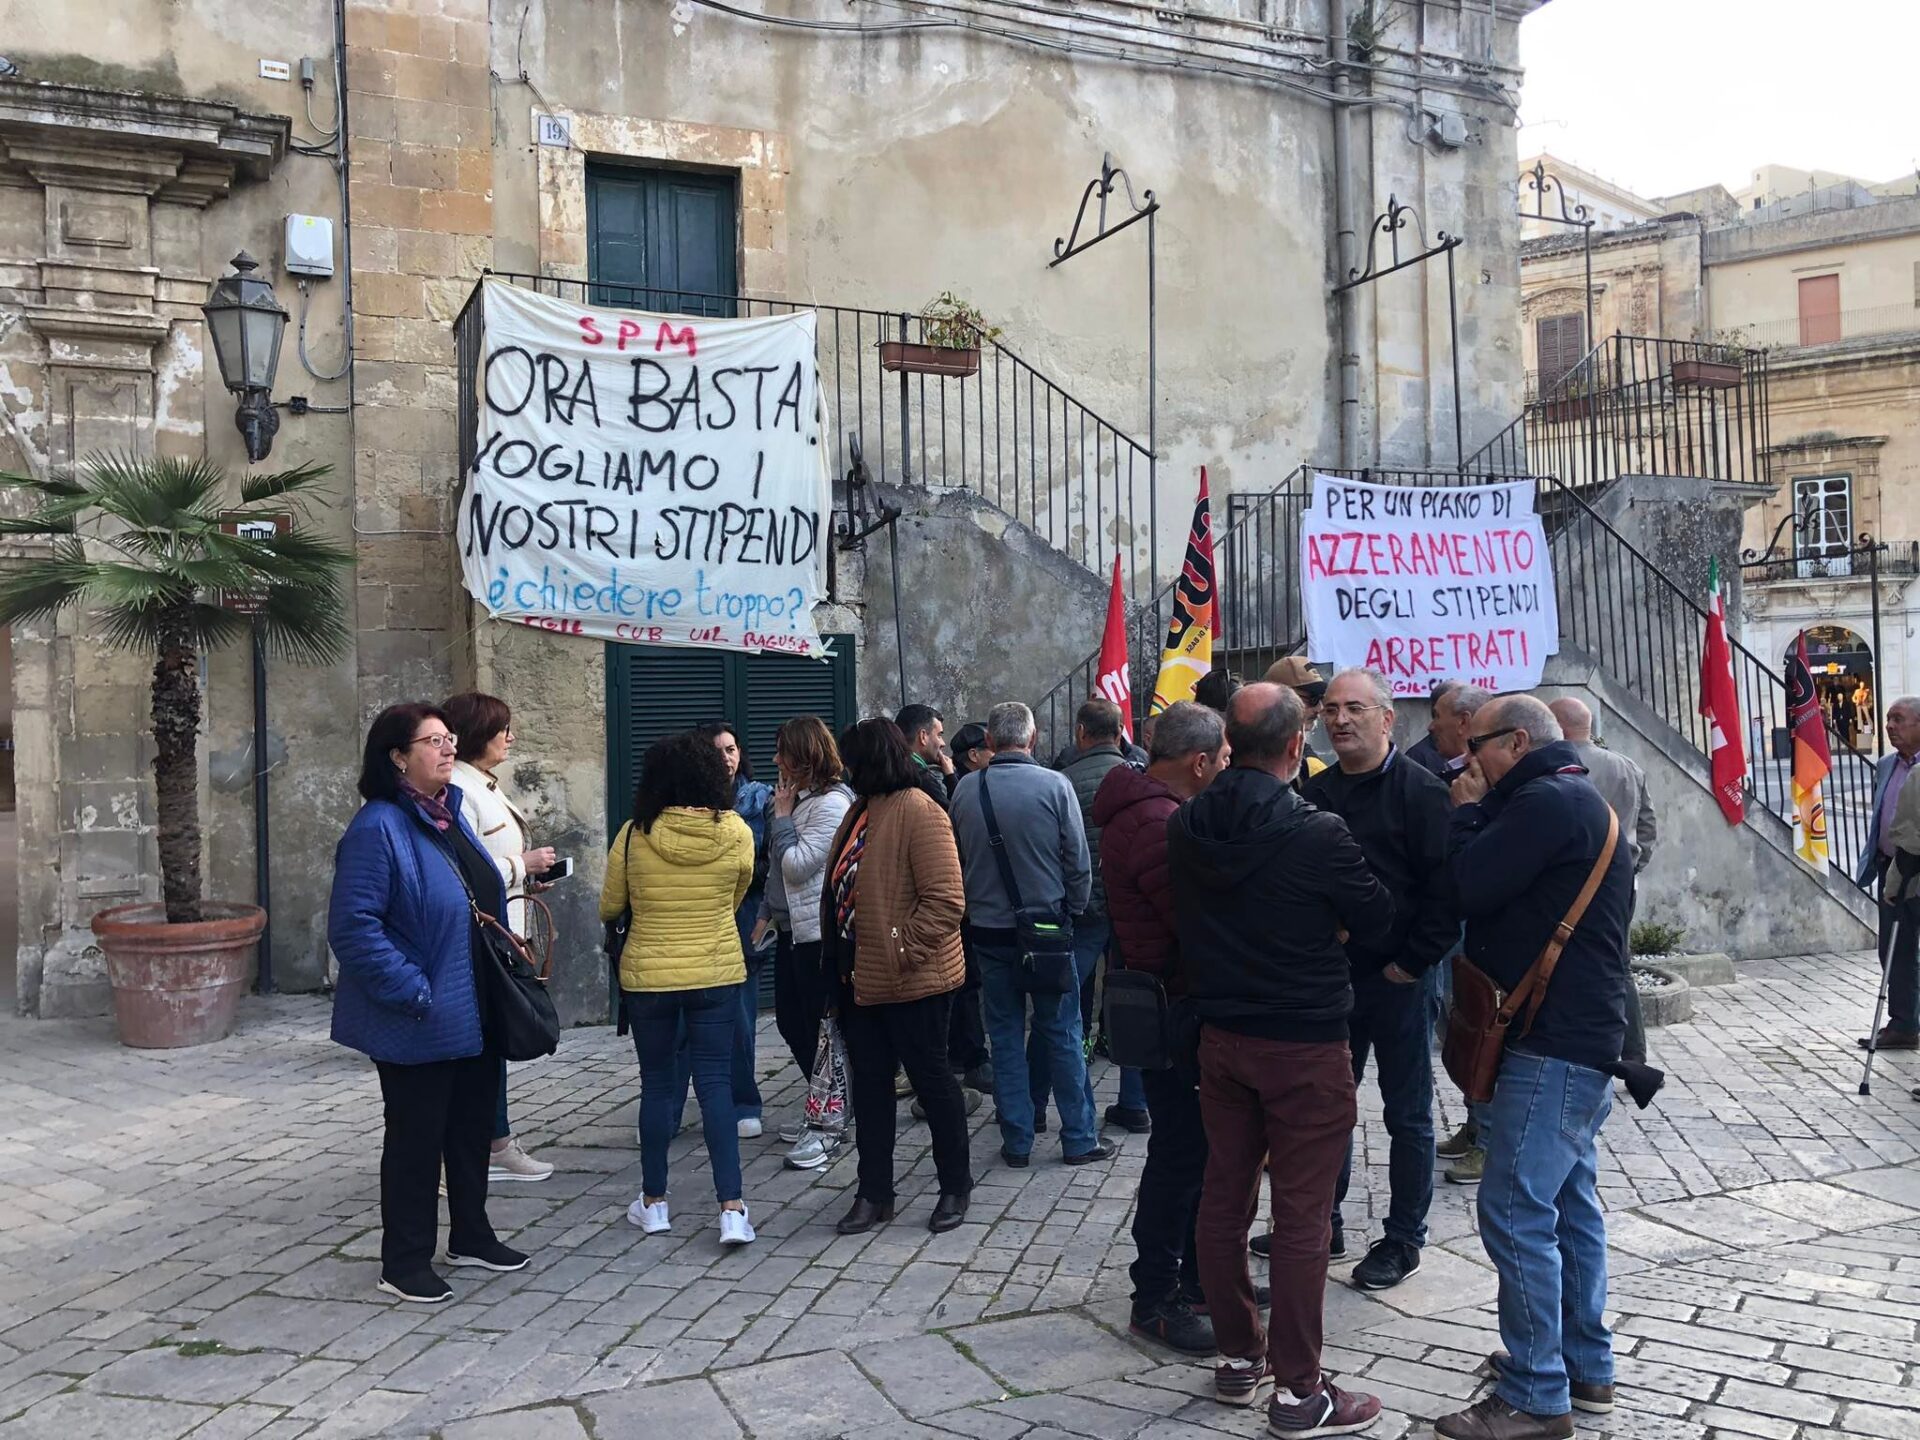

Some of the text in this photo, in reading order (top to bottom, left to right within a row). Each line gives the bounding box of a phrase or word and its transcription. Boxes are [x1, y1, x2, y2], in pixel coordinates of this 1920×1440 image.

[547, 122, 562, 140] 19
[577, 316, 697, 358] SPM
[485, 346, 601, 428] ORA
[752, 450, 765, 499] I
[1326, 487, 1511, 520] PER UN PIANO DI
[466, 493, 820, 566] NOSTRI STIPENDI
[1307, 529, 1534, 581] AZZERAMENTO
[487, 565, 806, 630] è chiedere troppo?
[1335, 584, 1540, 620] DEGLI STIPENDI
[616, 623, 663, 641] CUB
[690, 626, 729, 642] UIL
[1364, 629, 1530, 677] ARRETRATI
